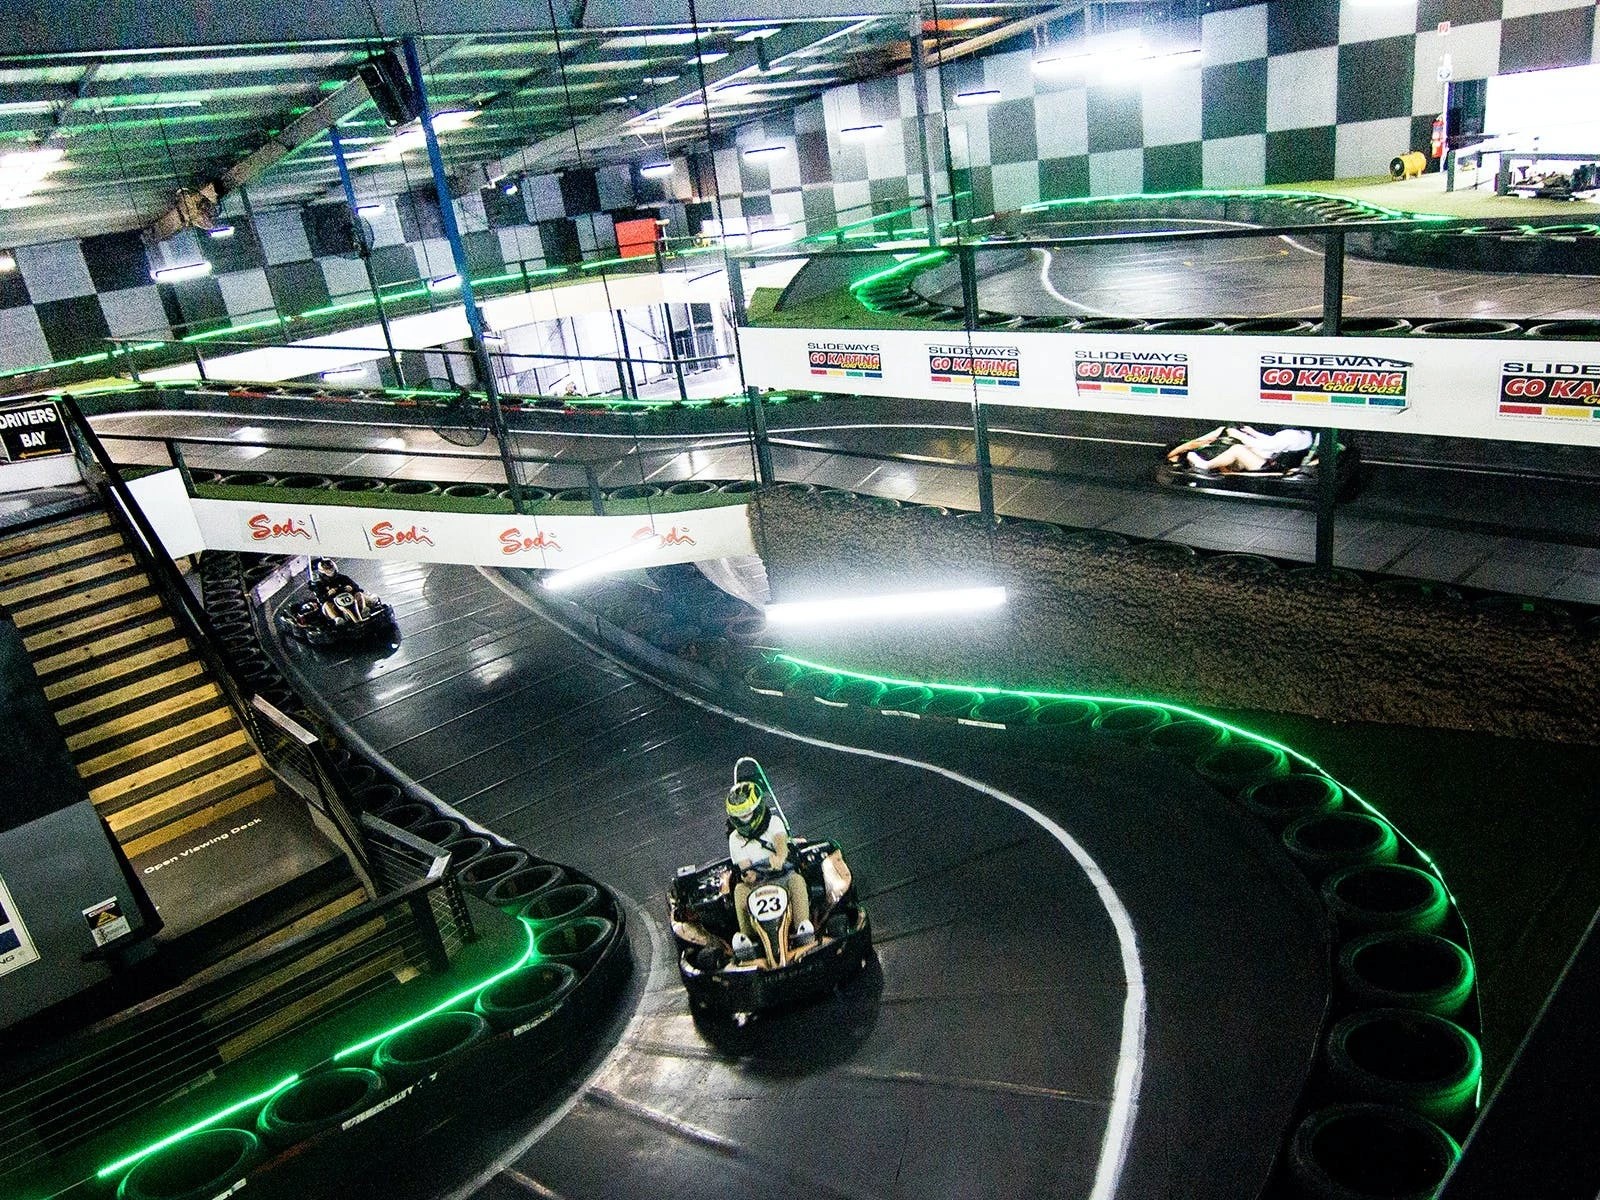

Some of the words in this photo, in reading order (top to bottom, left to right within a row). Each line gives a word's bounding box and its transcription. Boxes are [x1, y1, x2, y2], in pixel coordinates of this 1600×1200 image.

[807, 342, 880, 352] SLIDEWAYS
[928, 346, 1019, 357] SLIDEWAYS
[810, 353, 826, 365] GO
[827, 354, 880, 367] KARTING
[1074, 350, 1189, 362] SLIDEWAYS
[1260, 355, 1412, 368] SLIDEWAYS
[841, 361, 858, 369] Gold
[858, 362, 881, 370] Coast
[931, 357, 951, 371] GO
[952, 358, 1019, 373] KARTING
[990, 369, 1018, 377] Coast
[1078, 362, 1102, 377] GO
[1103, 363, 1185, 380] KARTING
[1124, 373, 1150, 383] Gold
[1151, 375, 1185, 385] Coast
[1263, 368, 1294, 385] GO
[1296, 369, 1404, 388] KARTING
[1322, 382, 1356, 393] Gold
[1358, 383, 1403, 395] Coast
[1504, 377, 1546, 397] GO
[1548, 379, 1600, 399] KA
[0, 407, 57, 430] DRIVERS
[19, 430, 47, 448] BAY
[248, 513, 312, 541] Sodi
[371, 521, 436, 549] Sodi
[498, 527, 563, 556] Sodi
[143, 856, 179, 875] Open
[179, 833, 229, 857] Viewing
[230, 818, 262, 835] Deck
[756, 897, 782, 916] 23
